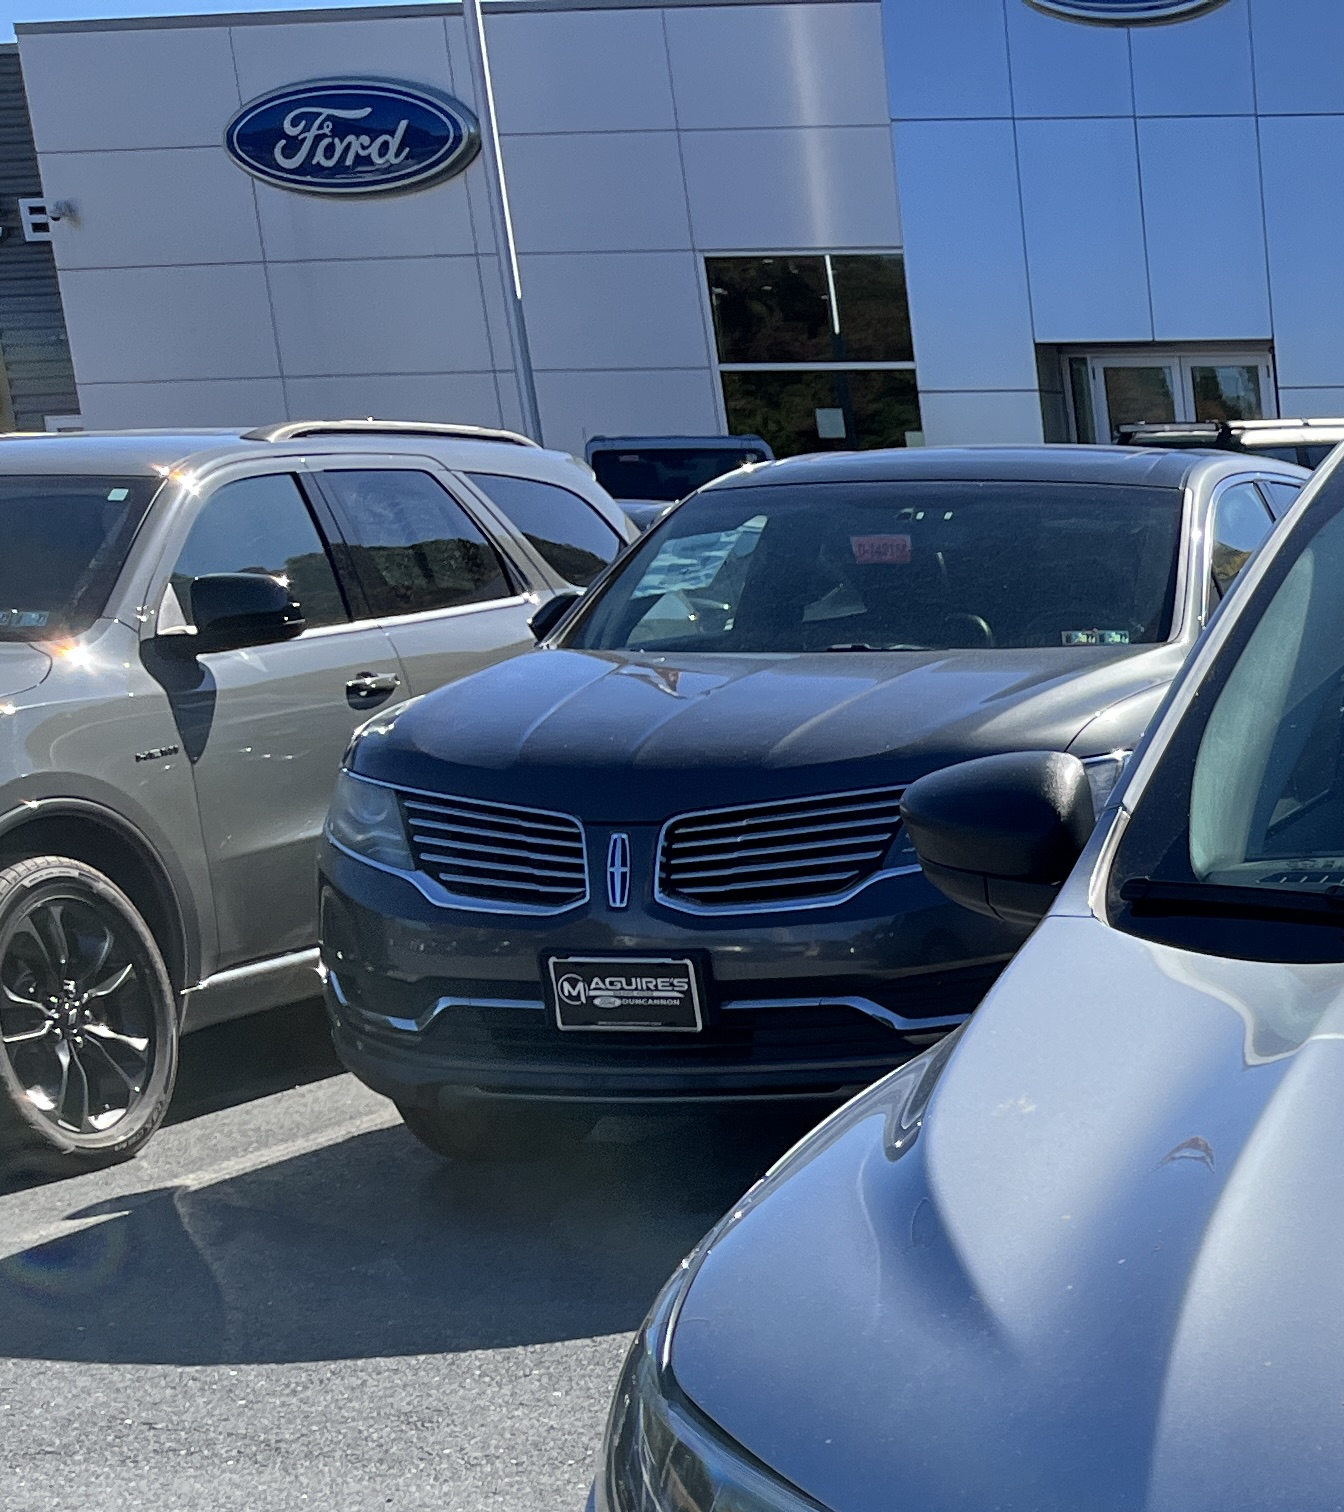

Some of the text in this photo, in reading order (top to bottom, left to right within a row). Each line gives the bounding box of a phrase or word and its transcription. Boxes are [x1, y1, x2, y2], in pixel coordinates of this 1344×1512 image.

[274, 107, 410, 169] Ford
[557, 973, 689, 1005] MAGUIRE'S
[622, 998, 680, 1006] DUNCANNON
